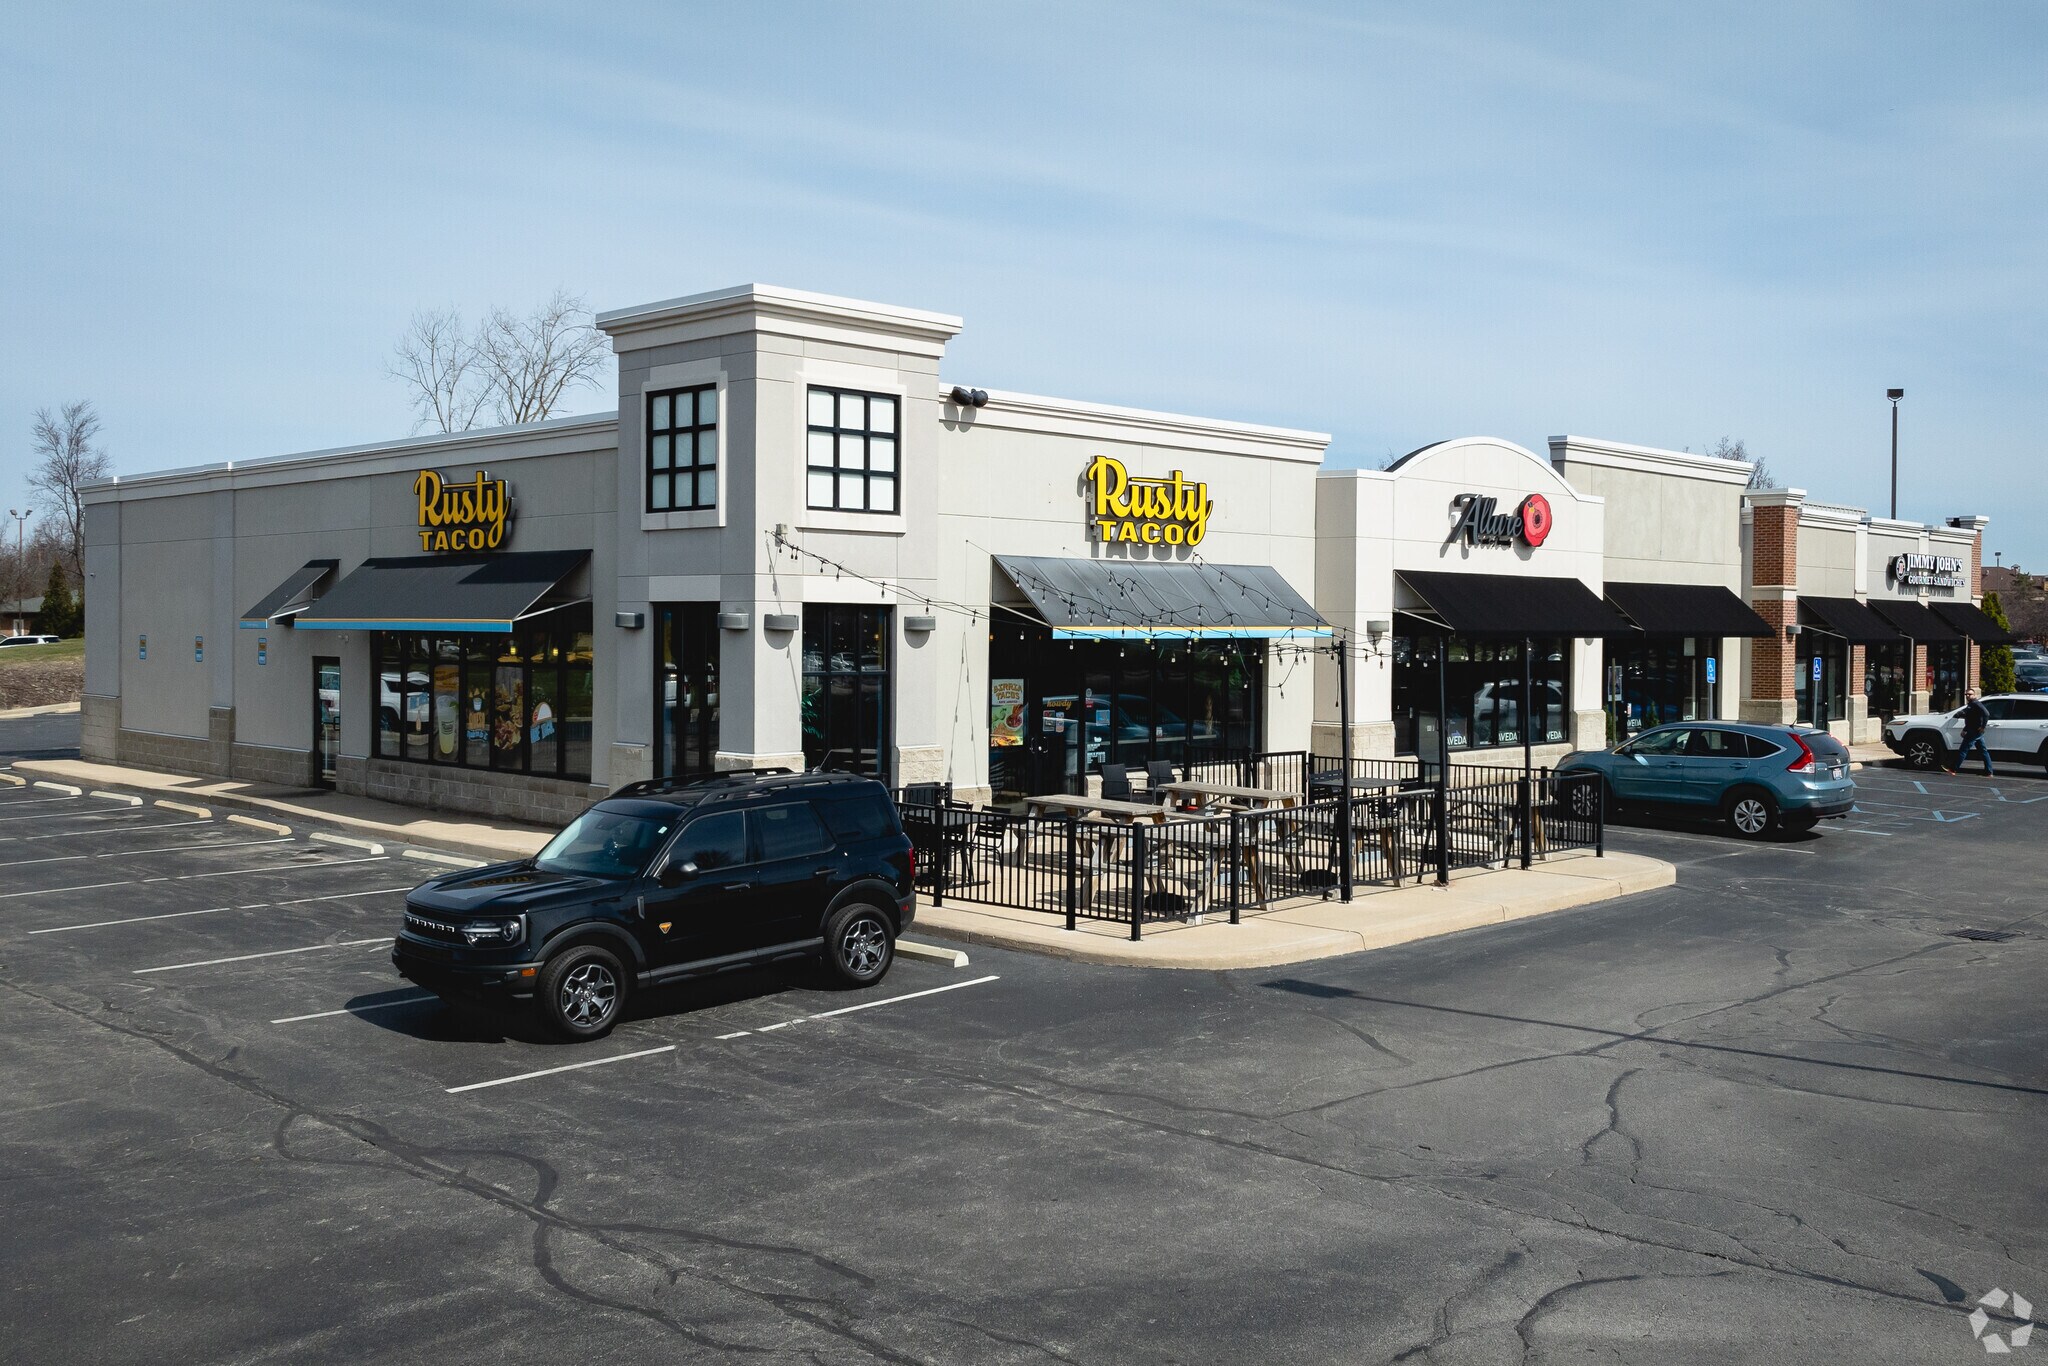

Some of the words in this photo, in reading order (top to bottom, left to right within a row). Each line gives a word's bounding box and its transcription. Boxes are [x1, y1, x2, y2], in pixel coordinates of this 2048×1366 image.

[413, 470, 512, 549] Rusty
[1087, 454, 1213, 546] Rusty
[1450, 493, 1523, 545] Allure
[418, 528, 486, 552] TACO
[1096, 520, 1185, 545] TACO
[1907, 553, 1935, 571] JIMMY
[1936, 556, 1963, 573] JOHN'S
[1908, 575, 1934, 585] GOURMET
[995, 691, 1020, 700] TACOS
[1046, 700, 1073, 710] howdy
[1546, 731, 1563, 740] VEDA
